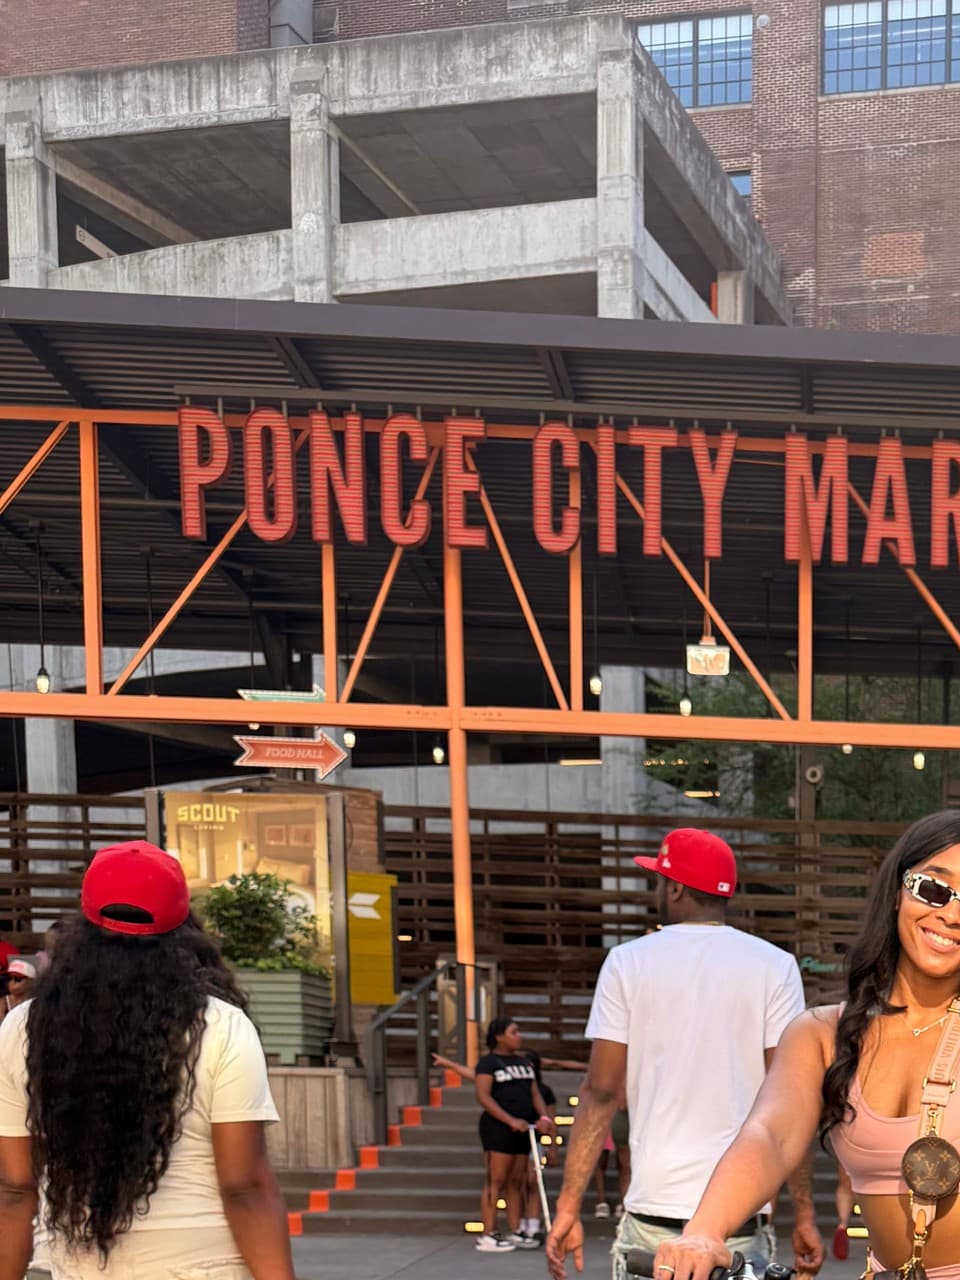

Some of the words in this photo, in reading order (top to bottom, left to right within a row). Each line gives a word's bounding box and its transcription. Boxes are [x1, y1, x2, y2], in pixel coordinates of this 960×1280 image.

[178, 404, 489, 550] PONCE
[532, 420, 739, 561] CITY
[265, 747, 295, 758] FOOD
[296, 749, 325, 760] HALL
[176, 803, 241, 823] SCOUT
